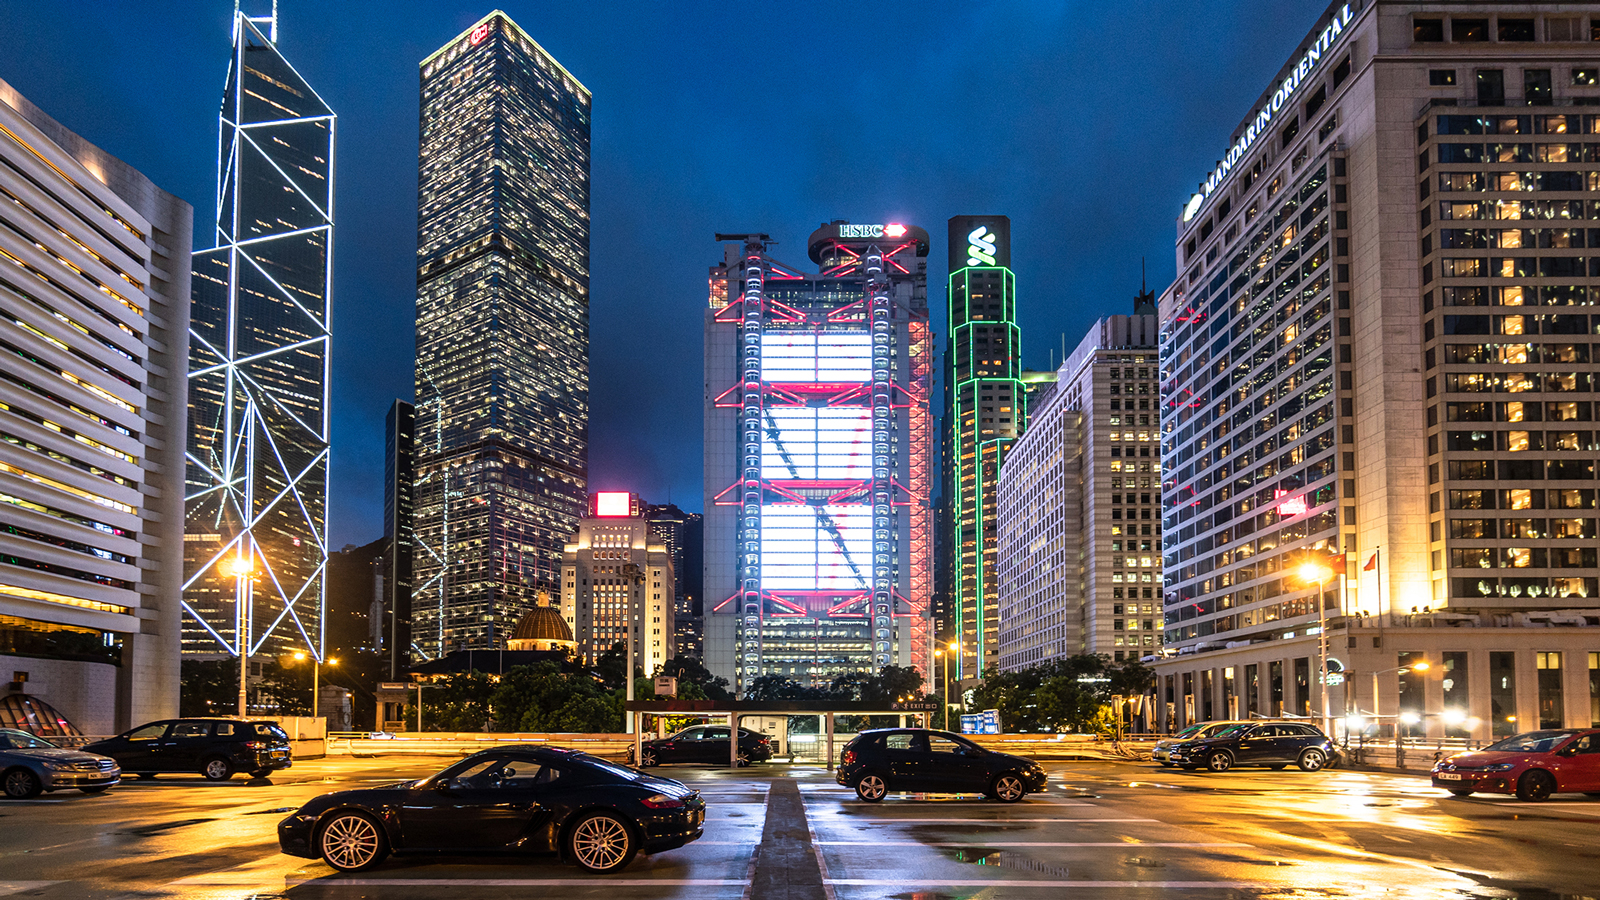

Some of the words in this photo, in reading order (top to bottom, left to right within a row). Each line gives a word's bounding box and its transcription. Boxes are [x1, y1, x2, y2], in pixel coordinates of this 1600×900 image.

[1205, 103, 1272, 198] MANDARIN
[1272, 3, 1355, 112] ORIENTAL
[839, 224, 884, 238] HSBC
